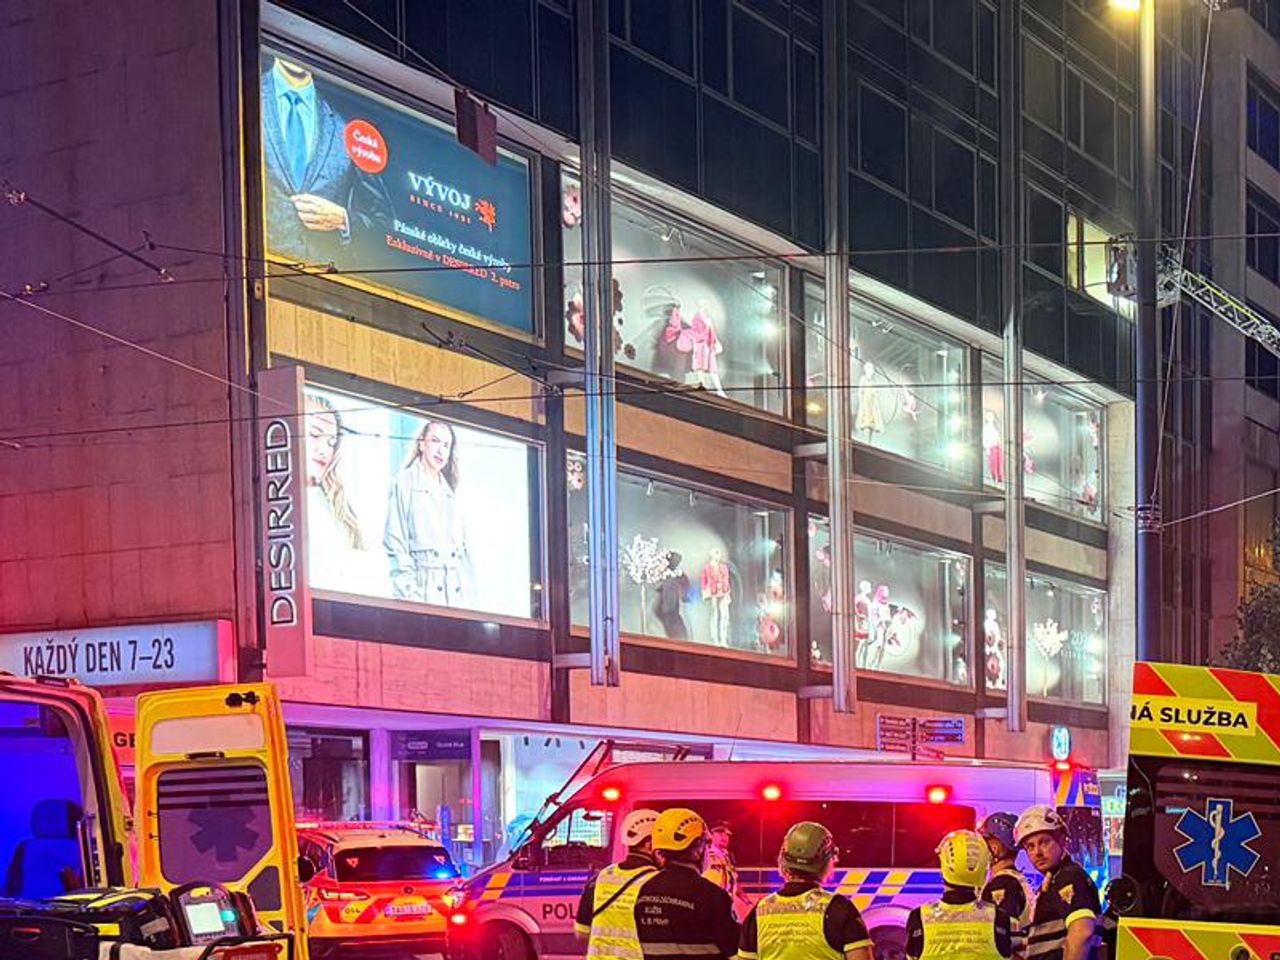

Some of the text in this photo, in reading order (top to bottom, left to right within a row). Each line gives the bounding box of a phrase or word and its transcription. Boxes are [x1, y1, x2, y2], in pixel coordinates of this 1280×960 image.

[408, 170, 472, 210] VÝVOJ
[264, 417, 297, 627] DESIRRED
[23, 637, 79, 676] KAŽDÝ
[86, 640, 122, 673] DEN
[1160, 704, 1249, 729] SLUŽBA
